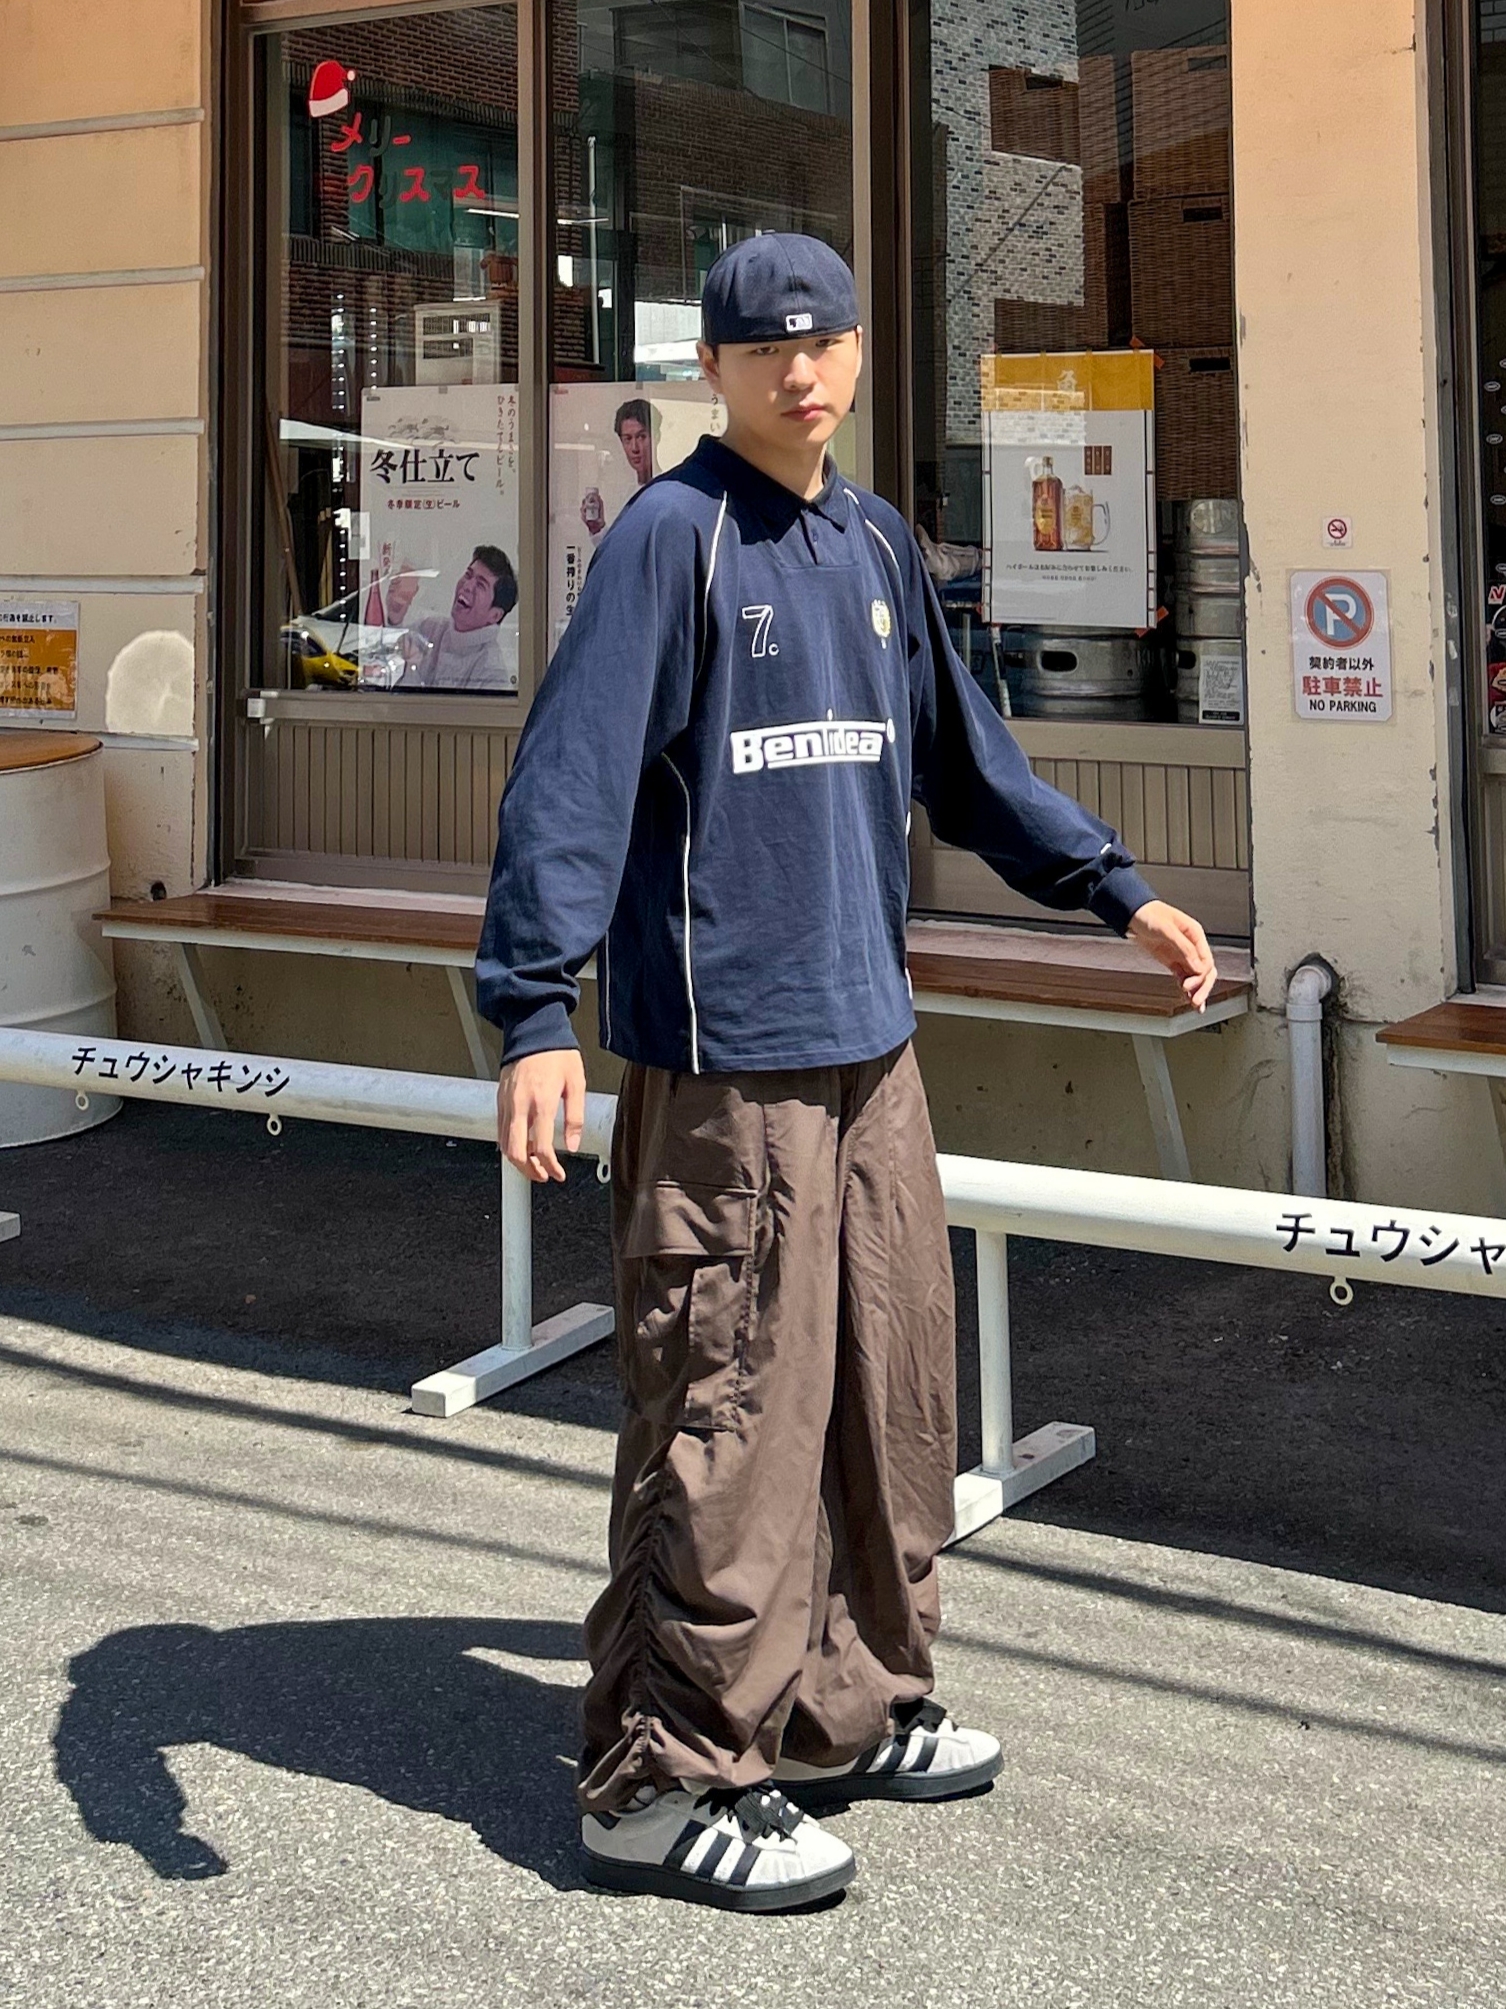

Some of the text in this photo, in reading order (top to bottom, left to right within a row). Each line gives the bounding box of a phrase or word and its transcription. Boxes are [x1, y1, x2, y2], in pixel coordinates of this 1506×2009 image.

[330, 111, 412, 157] メリー
[347, 164, 486, 209] クリスマス
[369, 448, 481, 484] 冬仕立て
[1309, 656, 1374, 671] 契約者以外
[1302, 675, 1384, 698] 駐車禁止
[1309, 699, 1377, 713] NO PARKING
[71, 1046, 291, 1098] チュウシャキンシ
[1275, 1212, 1506, 1275] チュウシャ
